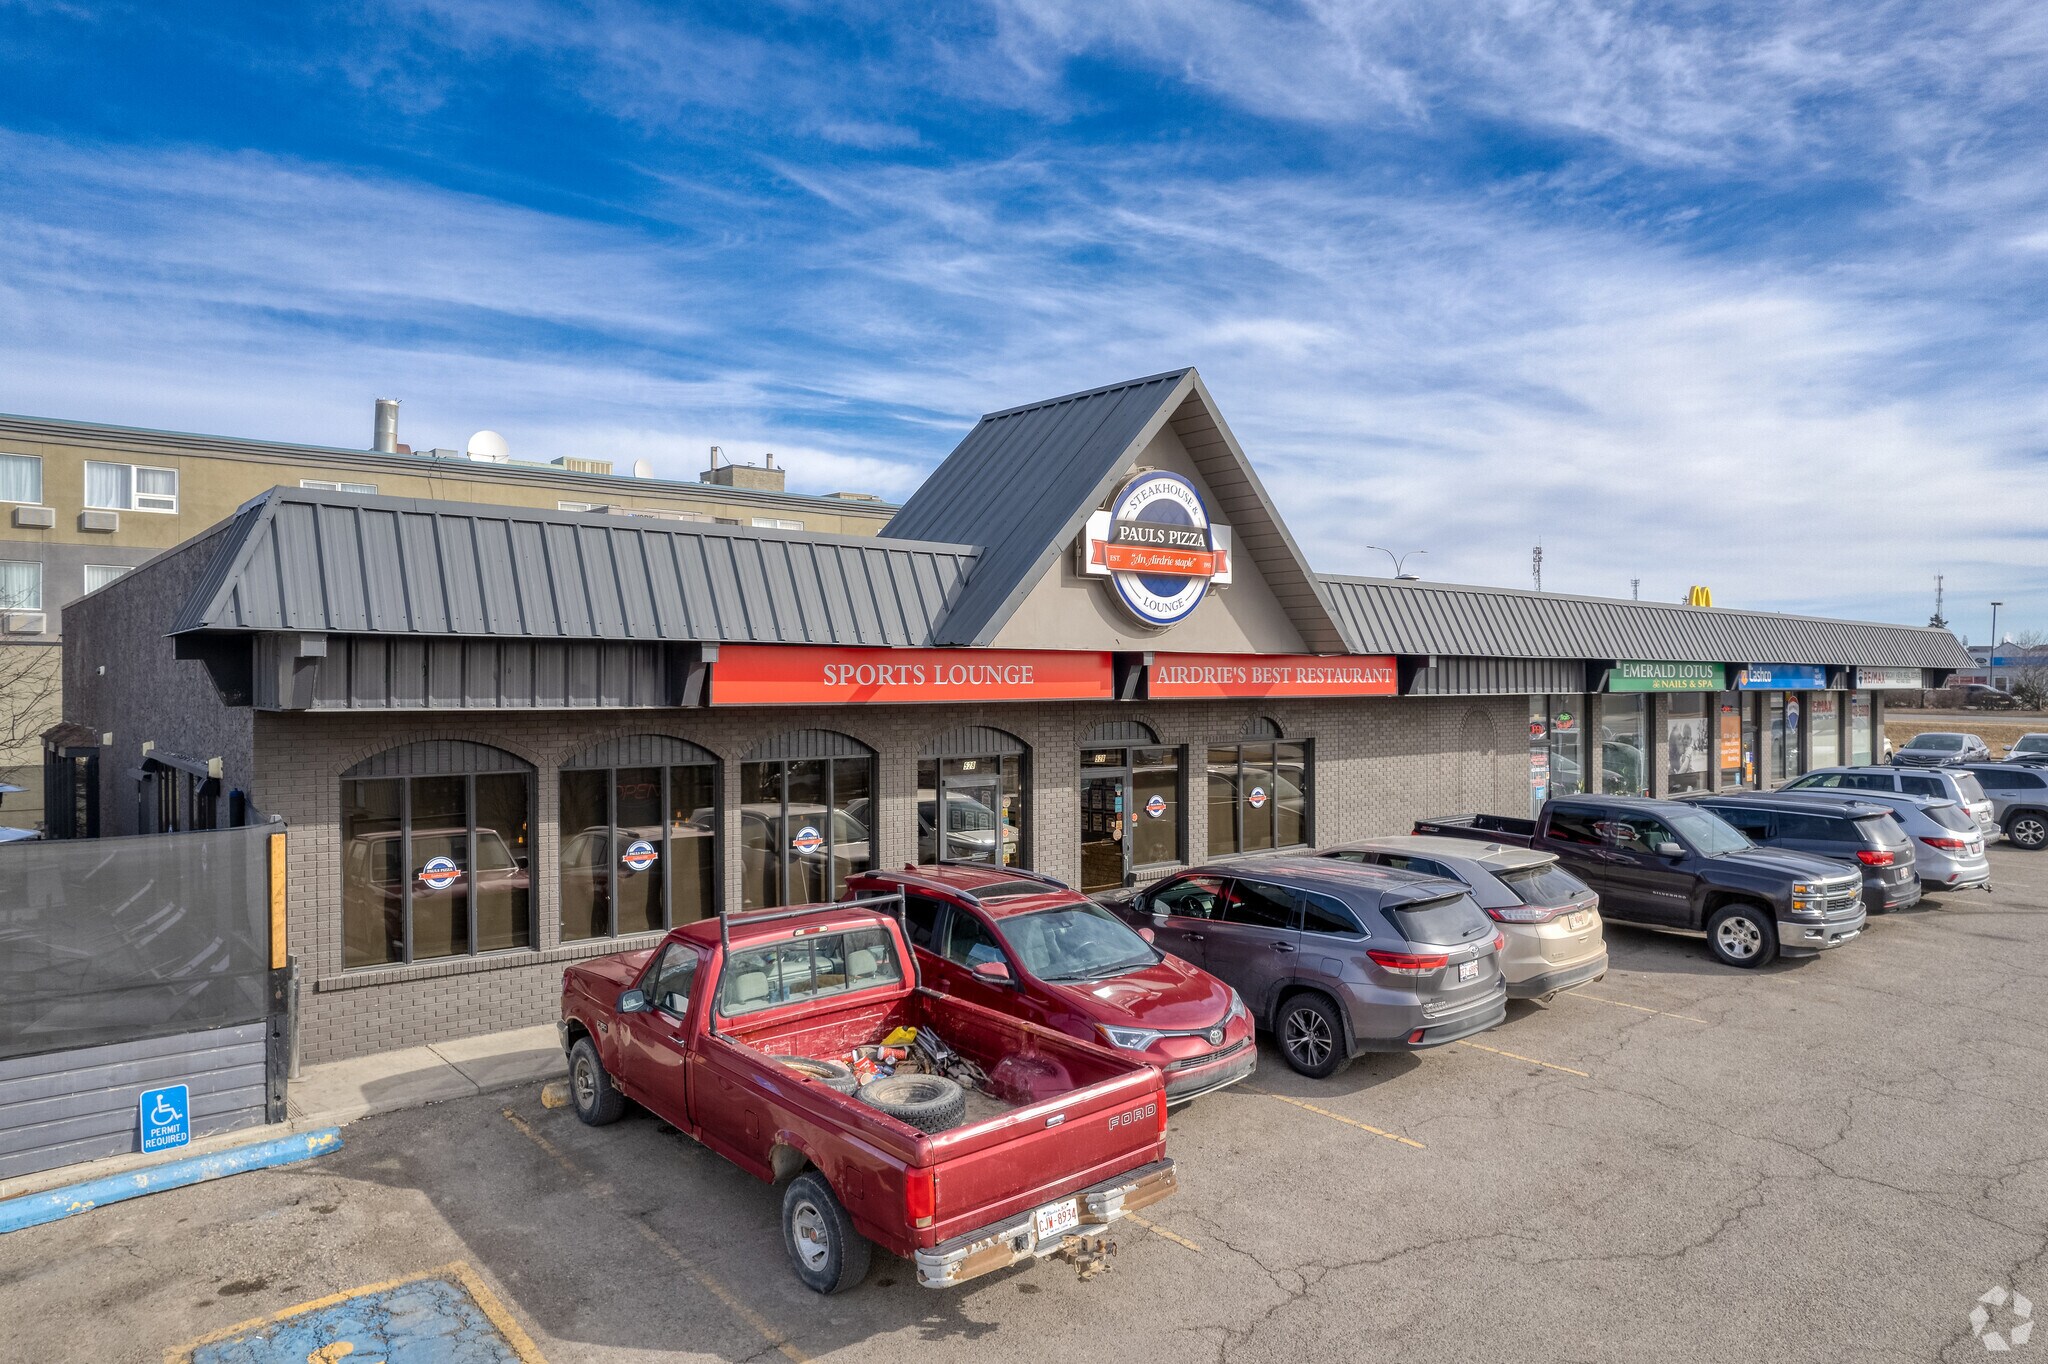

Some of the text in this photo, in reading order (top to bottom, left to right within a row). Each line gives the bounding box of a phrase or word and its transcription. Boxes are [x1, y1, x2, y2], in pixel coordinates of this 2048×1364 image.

[1129, 483, 1199, 516] STEAKHOUSE &
[1119, 525, 1206, 548] PAULS PIZZA
[1143, 597, 1185, 613] LOUNGE
[823, 663, 1034, 686] SPORTS LOUNGE
[1156, 666, 1392, 684] AIRDRIE'S BEST RESTAURANT
[1623, 663, 1713, 678] EMERALD LOTUS
[1748, 666, 1772, 683] Cashco
[1661, 680, 1713, 688] NAILS & SPA
[1108, 1103, 1157, 1131] FORD
[150, 1123, 181, 1138] PERMIT
[145, 1132, 187, 1149] REQUIRED
